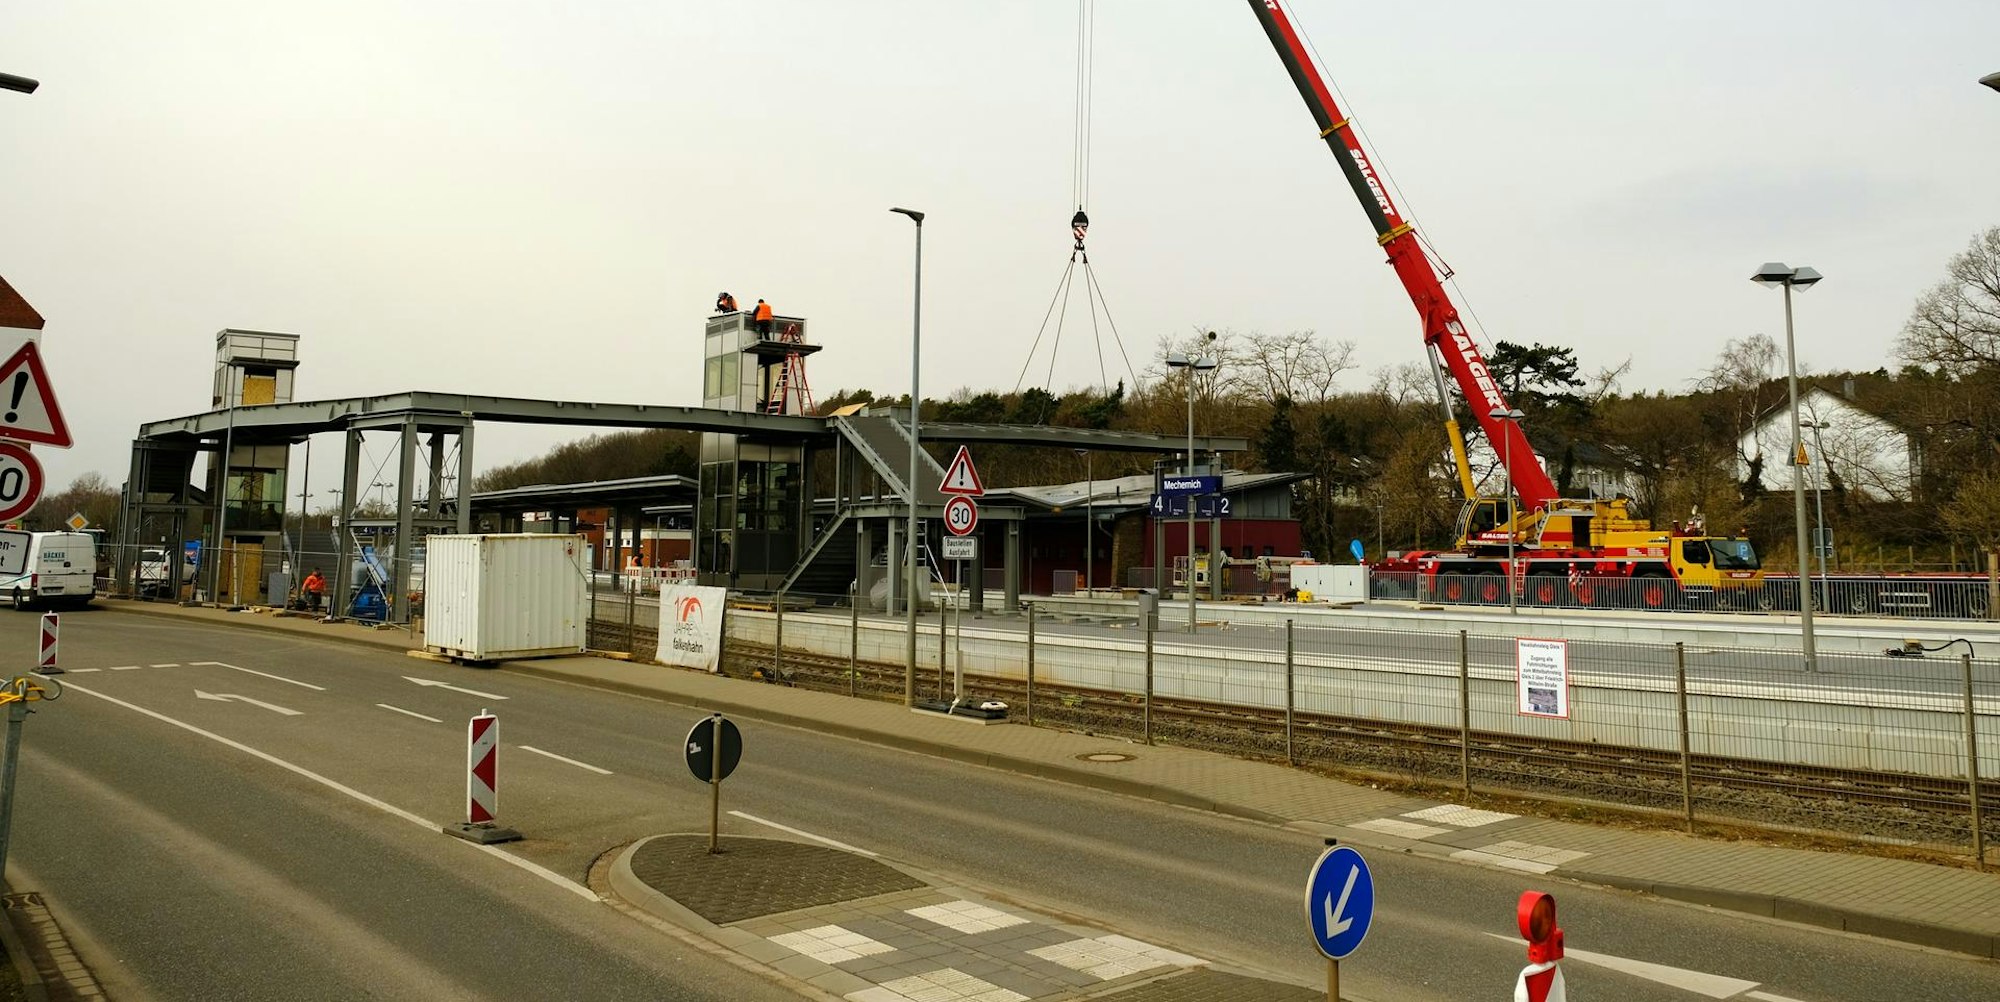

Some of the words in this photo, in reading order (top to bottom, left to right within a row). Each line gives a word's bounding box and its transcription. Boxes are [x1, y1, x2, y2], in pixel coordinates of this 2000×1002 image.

[1350, 148, 1396, 216] SALGERT
[0, 456, 24, 502] 0
[1163, 479, 1202, 490] Mechernich
[1154, 495, 1163, 512] 4
[1220, 497, 1229, 514] 2
[668, 516, 675, 527] 4
[951, 507, 970, 524] 30
[946, 539, 972, 547] Baustellen
[949, 548, 970, 556] Ausfahrt
